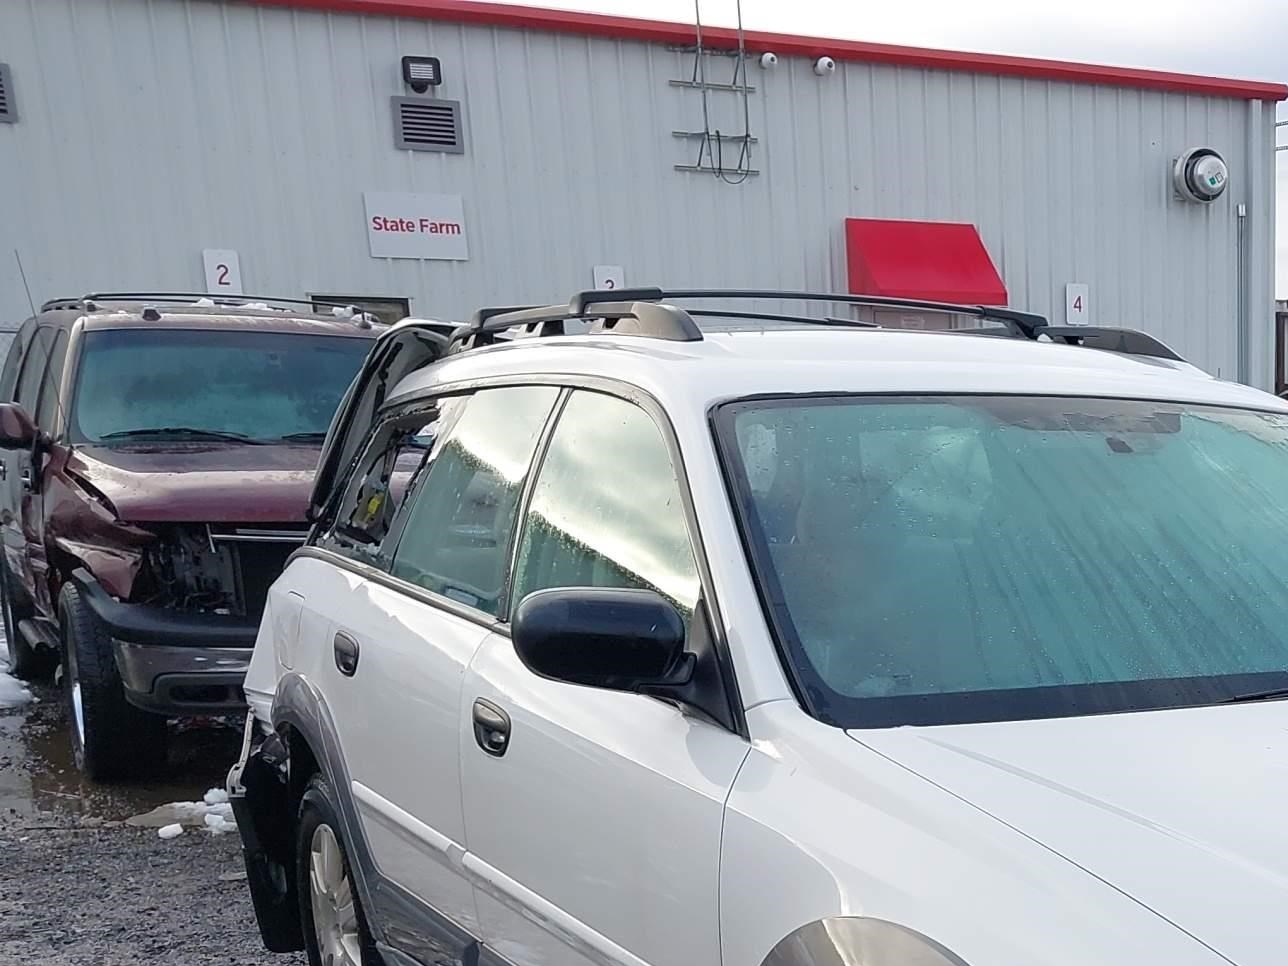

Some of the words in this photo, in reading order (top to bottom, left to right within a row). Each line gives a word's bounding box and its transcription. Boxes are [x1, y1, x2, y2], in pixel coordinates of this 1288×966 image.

[372, 216, 415, 232] State
[419, 218, 461, 234] Farm
[216, 264, 231, 285] 2
[1073, 295, 1082, 313] 4
